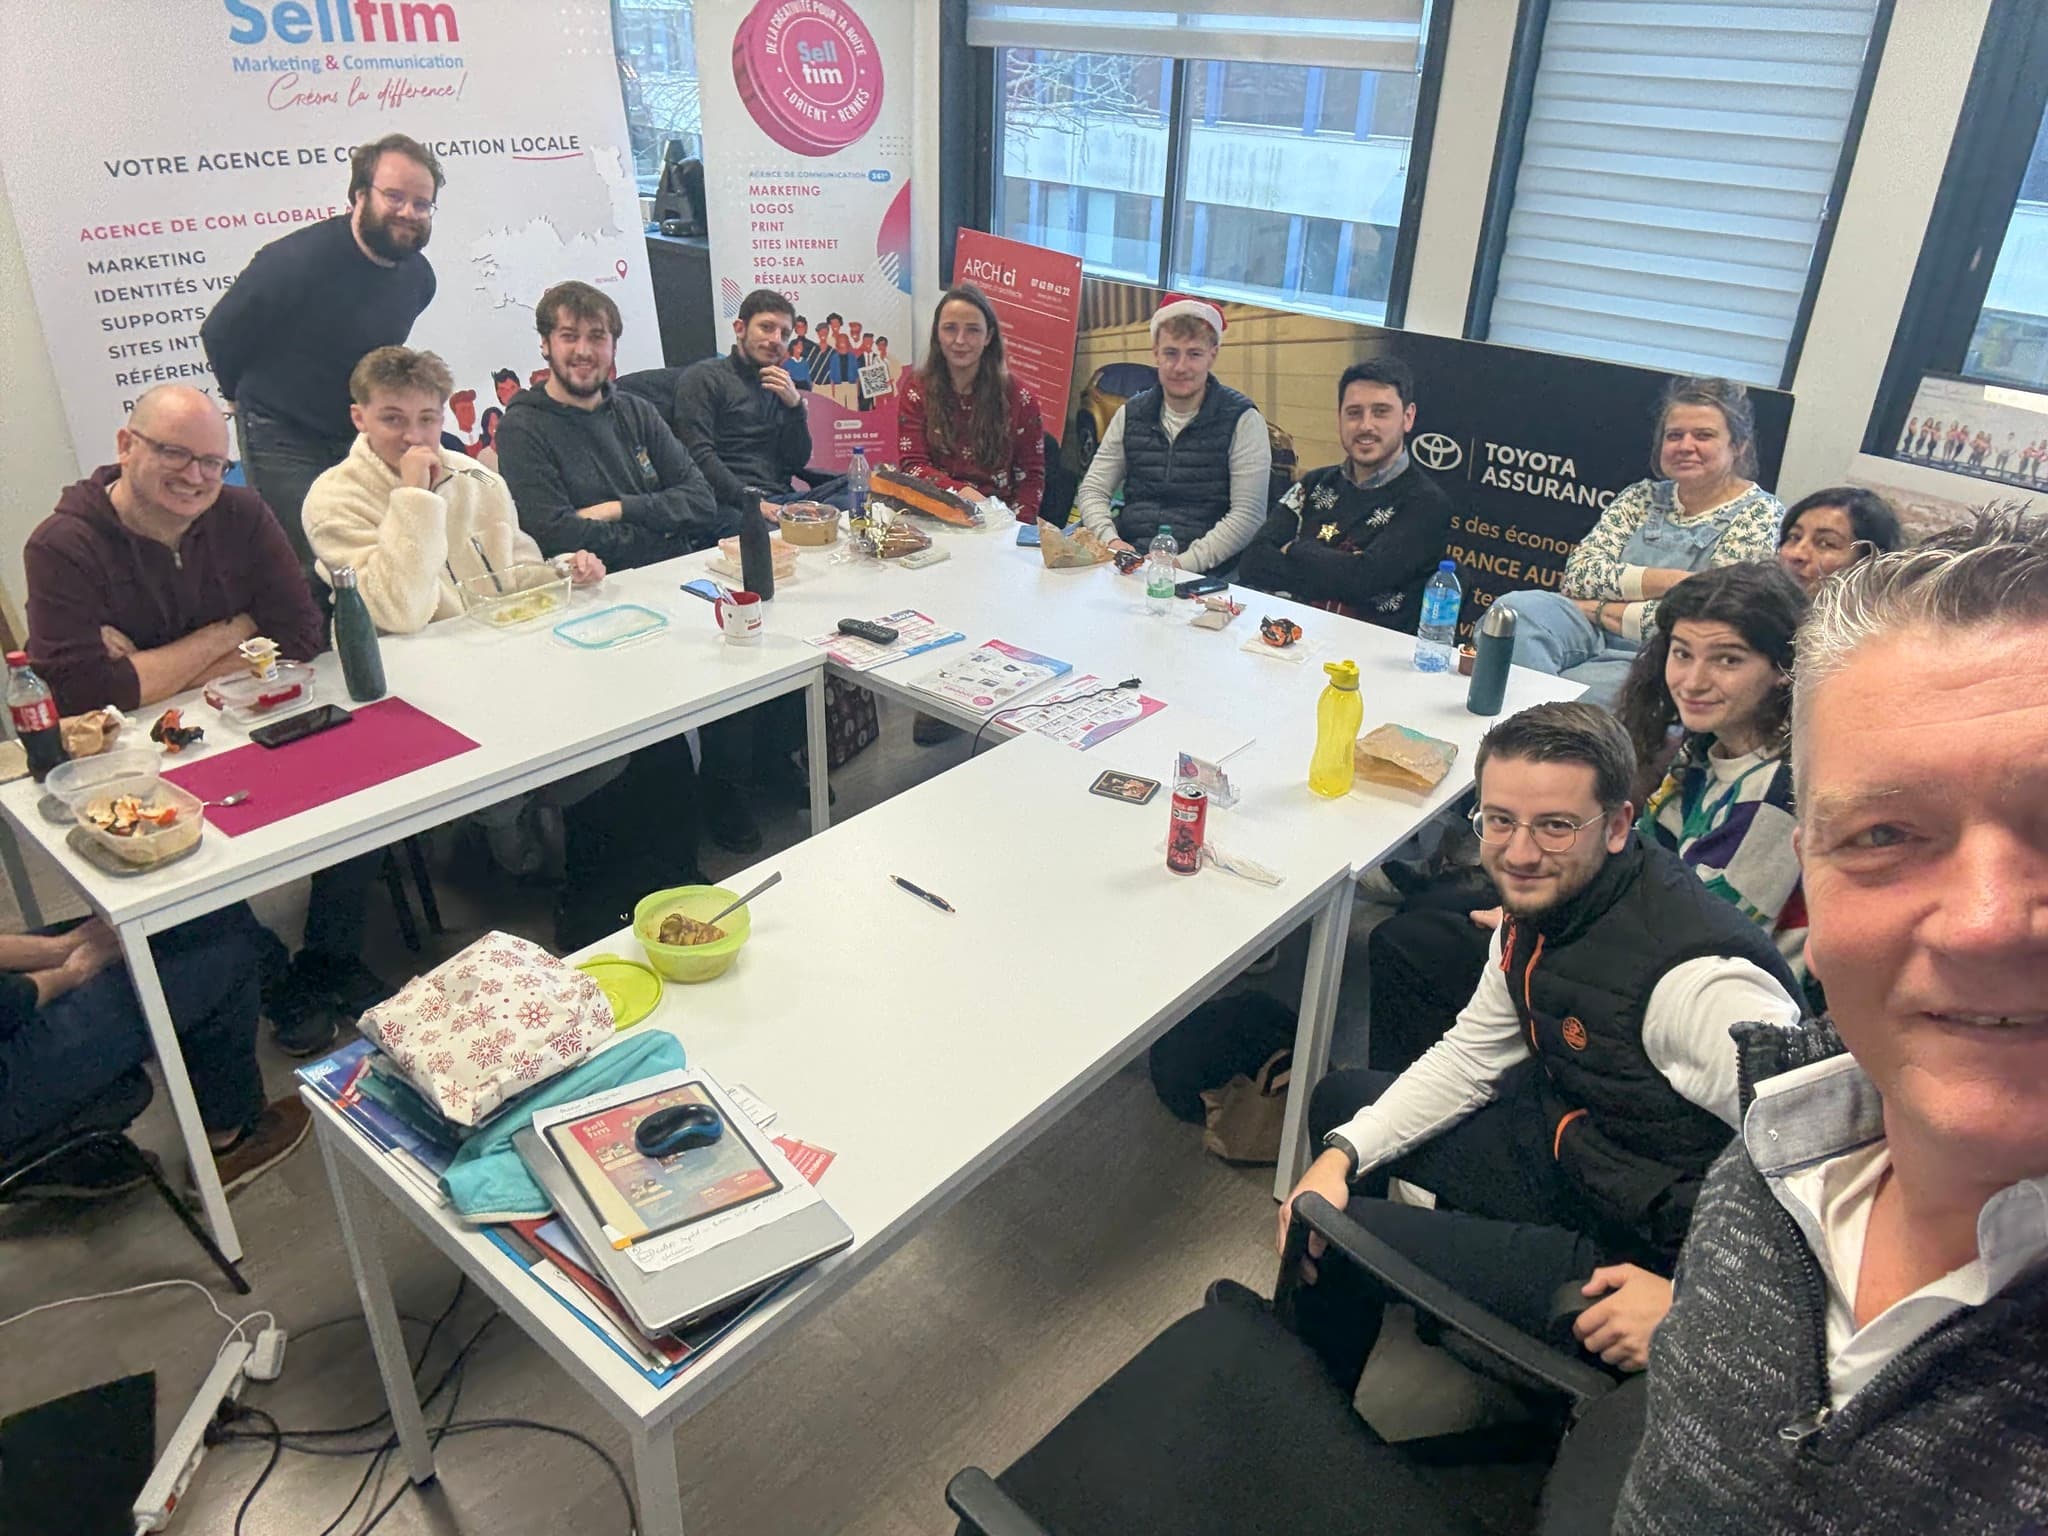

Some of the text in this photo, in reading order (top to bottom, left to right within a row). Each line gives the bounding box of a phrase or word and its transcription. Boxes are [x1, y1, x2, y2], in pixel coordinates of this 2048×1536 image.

[836, 15, 848, 31] TA
[797, 40, 838, 62] Sell
[232, 54, 464, 74] Marketing & Communication
[802, 61, 843, 84] tim
[268, 72, 338, 111] Créons
[348, 76, 369, 107] la
[783, 87, 870, 122] LORIENT RENNES
[104, 156, 189, 178] VOTRE
[198, 150, 291, 173] AGENCE
[297, 147, 328, 166] DE
[511, 135, 580, 153] LOCALE
[749, 185, 821, 197] MARKETING
[750, 203, 794, 215] LOGOS
[80, 220, 164, 243] AGENCE
[171, 217, 199, 234] DE
[205, 213, 247, 230] COM
[254, 206, 337, 226] GLOBALE
[751, 221, 784, 232] PRINT
[752, 239, 839, 250] SITES INTERNET
[88, 250, 206, 276] MARKETING
[753, 256, 805, 268] SEO-SEA
[95, 274, 240, 303] IDENTITÉS VIS
[754, 271, 865, 285] RÉSEAUX SOCIAUX
[101, 306, 207, 331] SUPPORTS
[108, 340, 163, 359] SITES
[1485, 442, 1577, 479] TOYOTA
[1465, 515, 1501, 539] des
[1473, 587, 1496, 608] te
